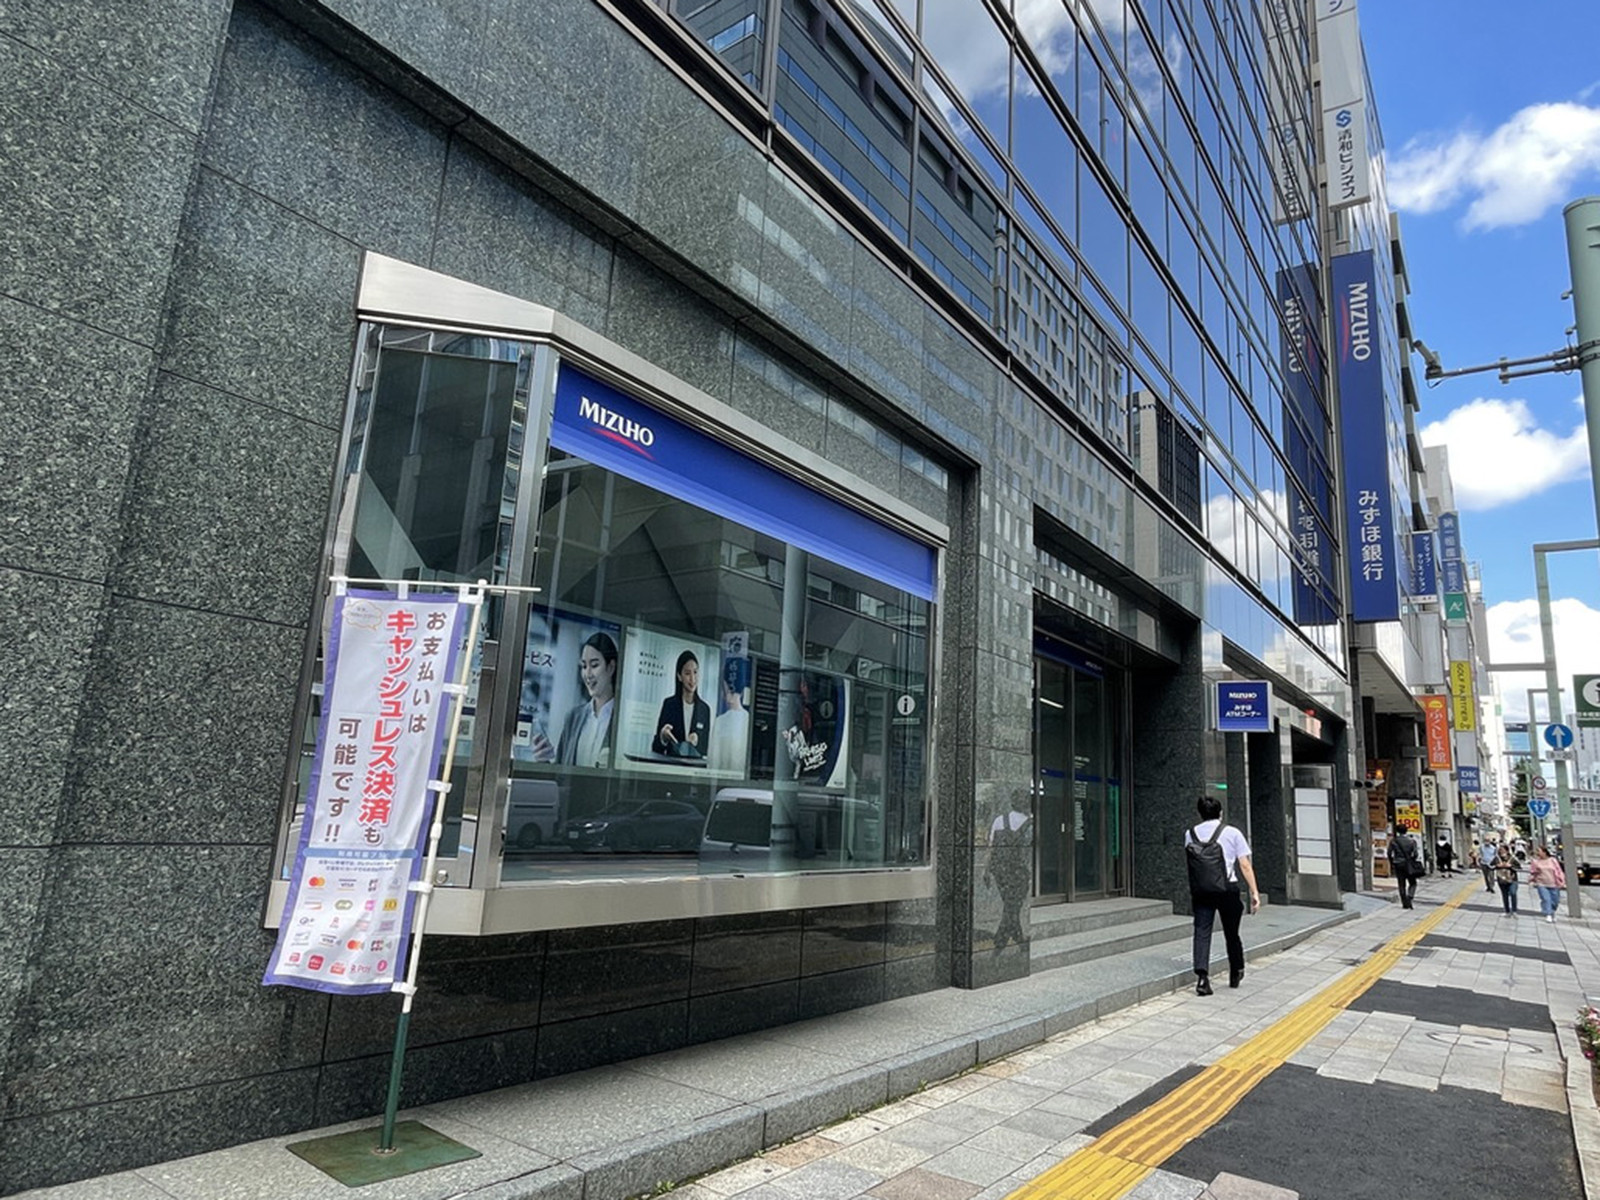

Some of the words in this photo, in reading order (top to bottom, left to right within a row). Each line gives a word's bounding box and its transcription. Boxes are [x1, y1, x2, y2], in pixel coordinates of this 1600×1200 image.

[1338, 128, 1356, 200] 清和ビジネス
[1348, 281, 1372, 362] MIZUHO
[578, 396, 655, 447] MIZUHO
[1358, 490, 1385, 582] みずほ銀行
[407, 612, 447, 734] お支払いは
[357, 609, 418, 846] キャッシュレス決済も
[1429, 710, 1447, 765] ふくしま館
[1460, 770, 1477, 778] DK
